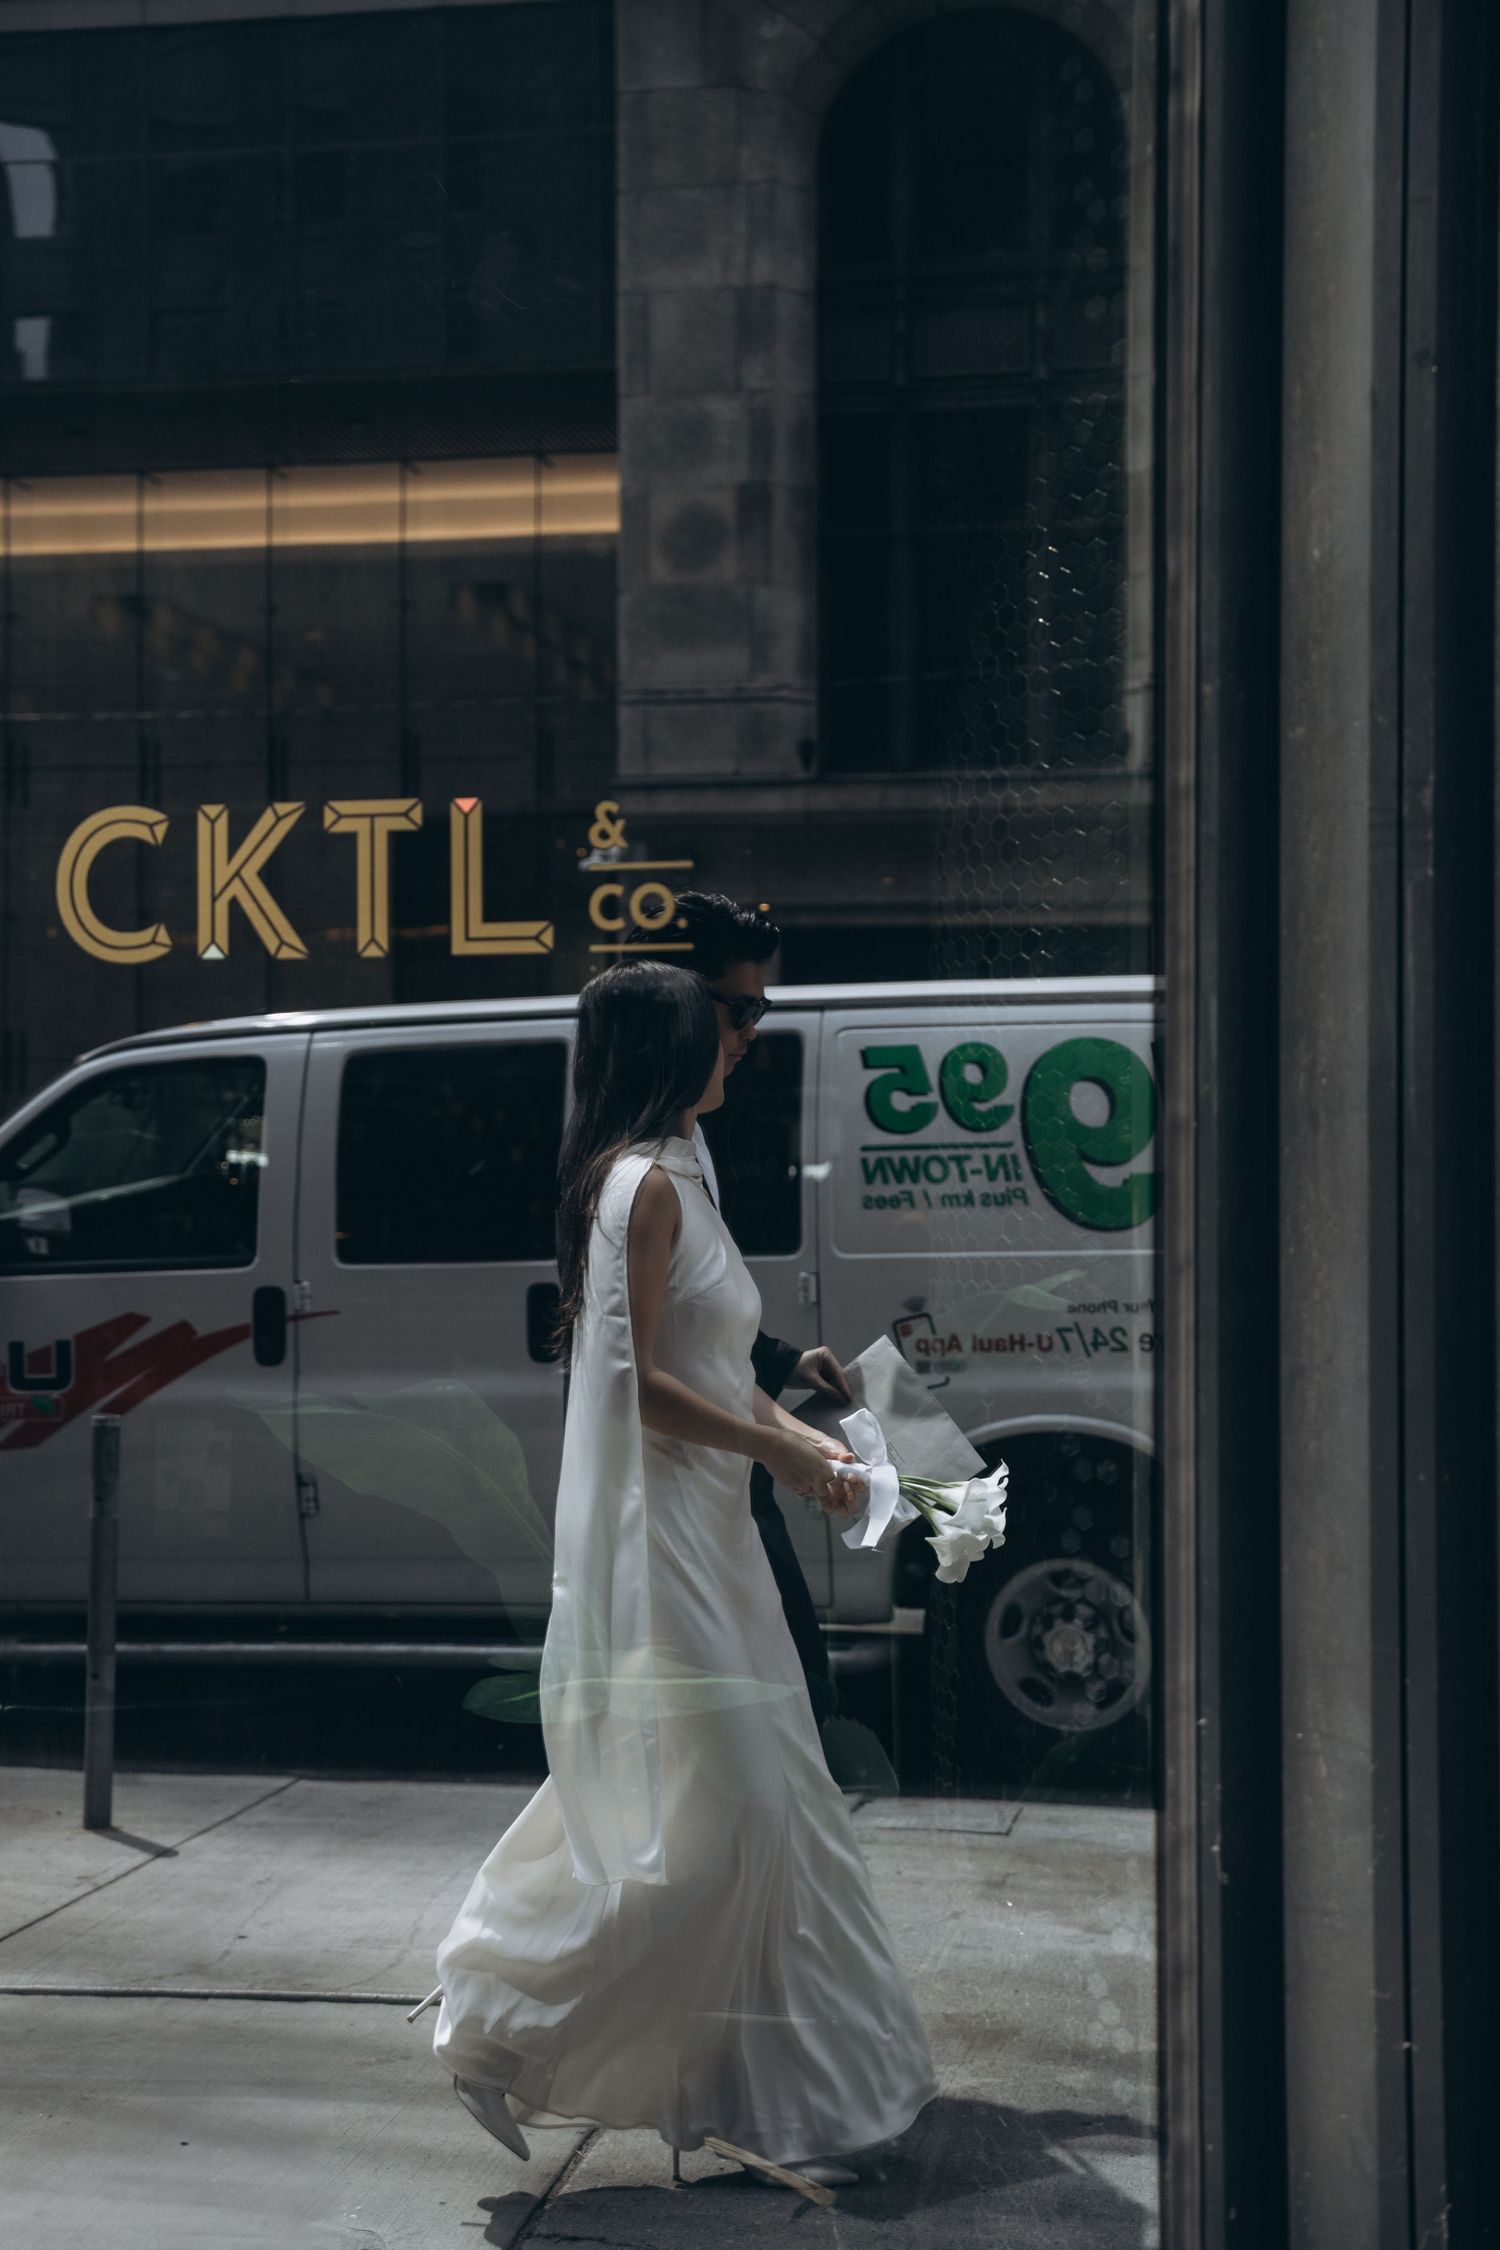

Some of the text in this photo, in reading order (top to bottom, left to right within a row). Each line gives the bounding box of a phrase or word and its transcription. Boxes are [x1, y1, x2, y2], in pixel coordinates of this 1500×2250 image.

[588, 800, 628, 851] &
[56, 797, 554, 964] CKTL
[589, 882, 688, 930] CO.
